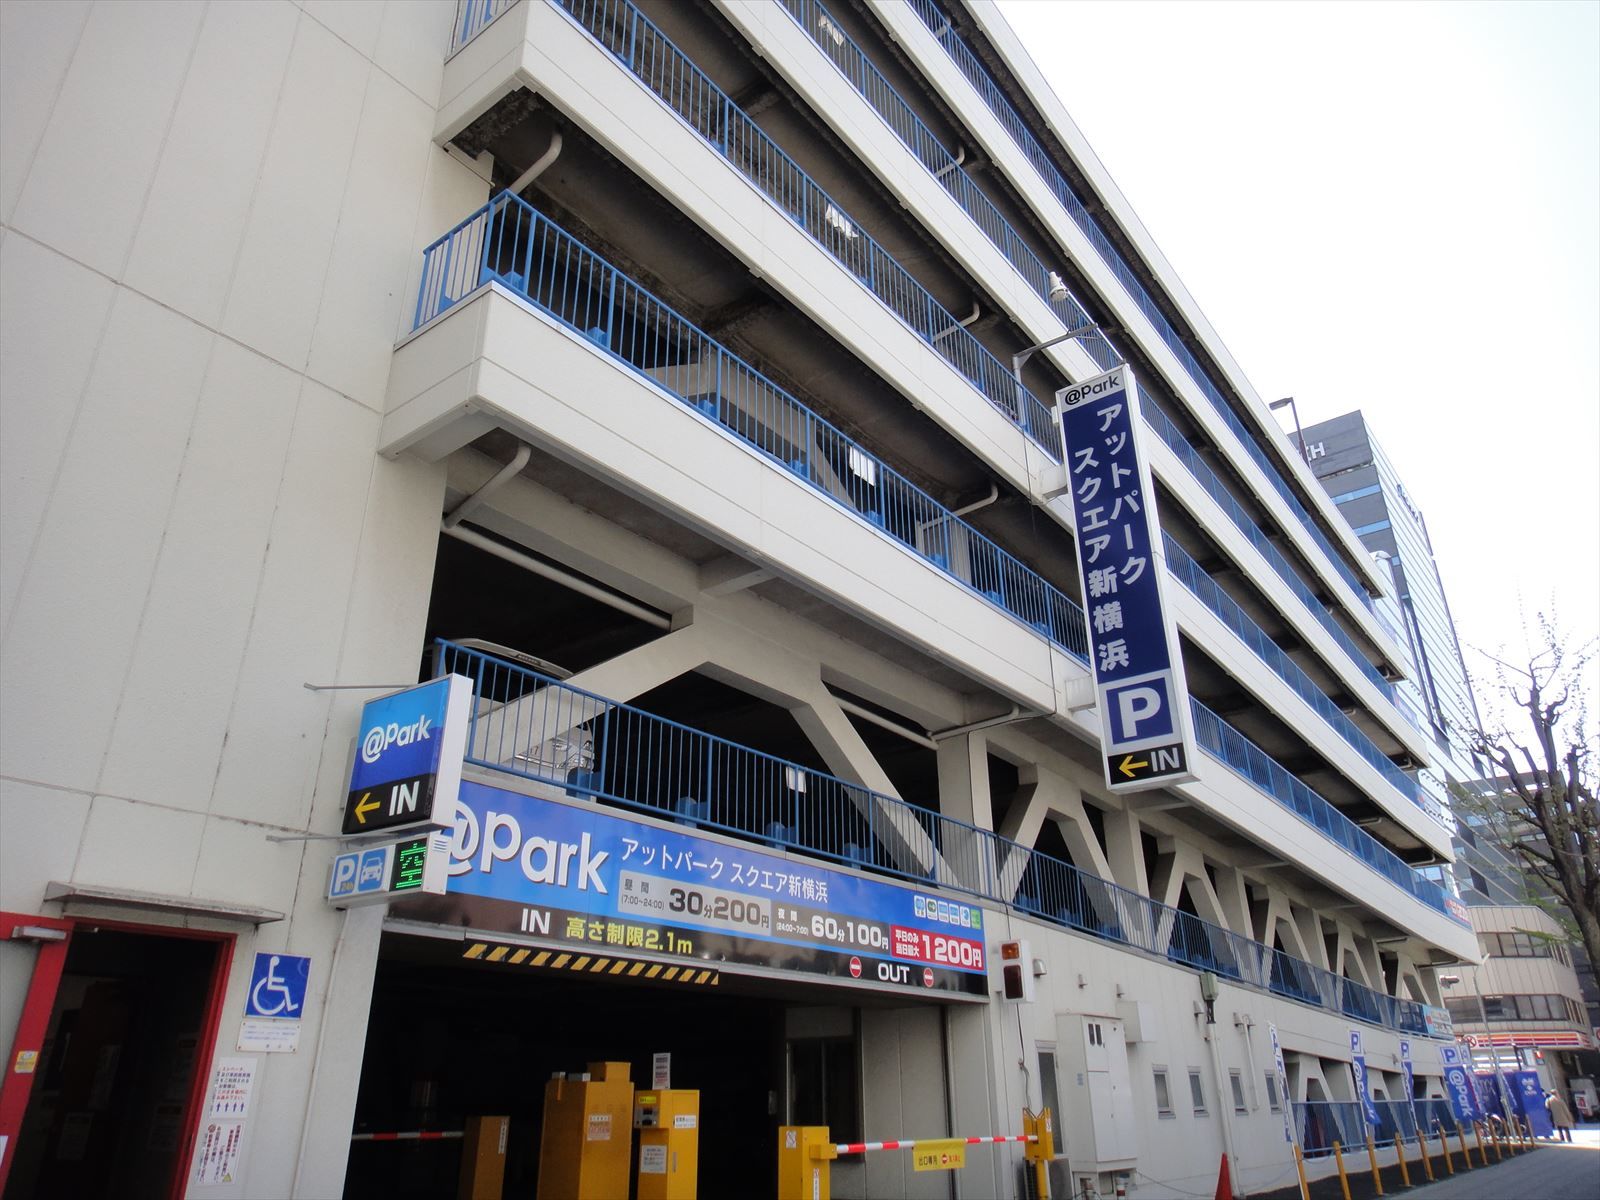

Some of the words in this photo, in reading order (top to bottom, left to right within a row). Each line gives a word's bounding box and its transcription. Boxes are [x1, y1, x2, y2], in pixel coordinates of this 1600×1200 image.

[1065, 375, 1119, 406] @Park
[1096, 403, 1147, 585] アットパーク
[1074, 447, 1129, 672] スクエア新横浜
[1118, 687, 1161, 739] P
[361, 714, 432, 764] @Park
[1150, 747, 1181, 772] IN
[388, 781, 420, 817] IN
[334, 858, 355, 893] P
[621, 837, 724, 880] アットパーク
[730, 862, 828, 903] スクエア新横浜
[520, 908, 552, 935] IN
[566, 917, 693, 955] 高さ制限2.1m
[922, 934, 982, 968] 1200円
[877, 963, 910, 984] OUT
[1443, 1048, 1456, 1062] P
